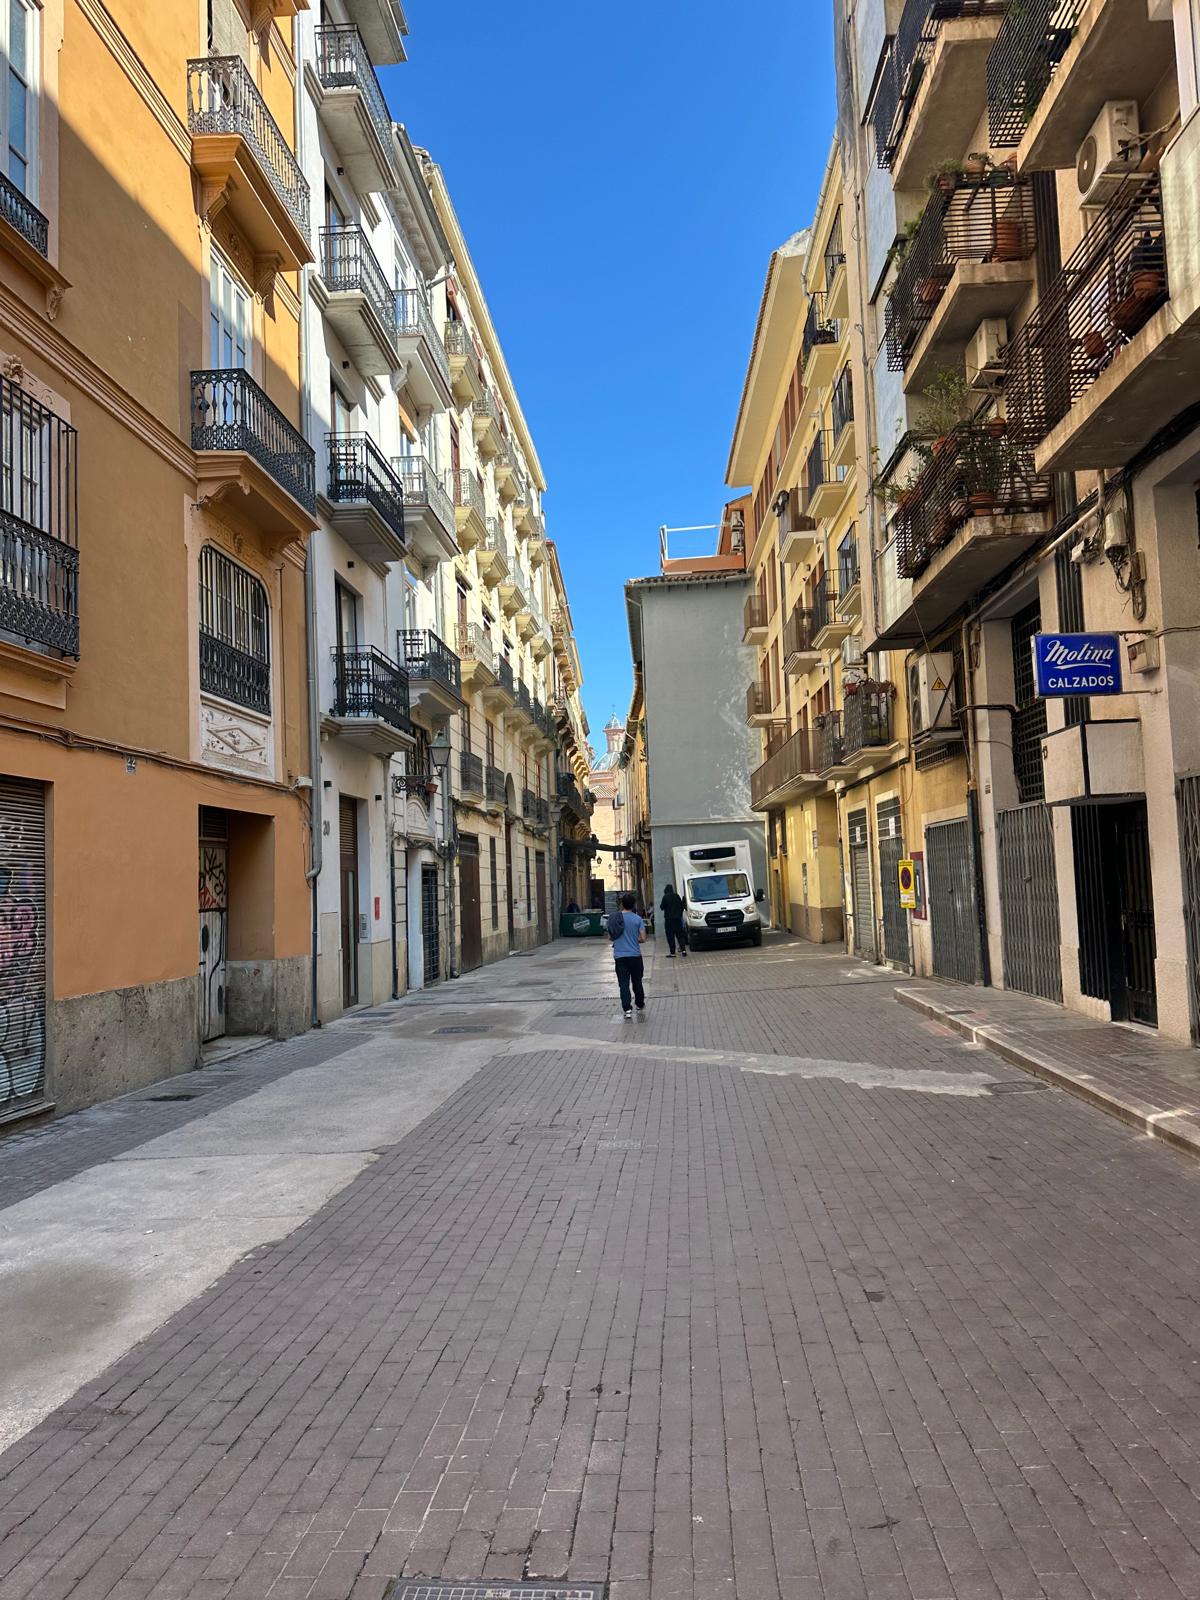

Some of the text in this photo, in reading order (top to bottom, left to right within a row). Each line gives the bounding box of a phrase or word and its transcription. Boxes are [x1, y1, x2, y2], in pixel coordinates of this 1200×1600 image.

[1044, 640, 1114, 665] Molina
[1048, 676, 1114, 688] CALZADOS
[323, 819, 330, 836] 20
